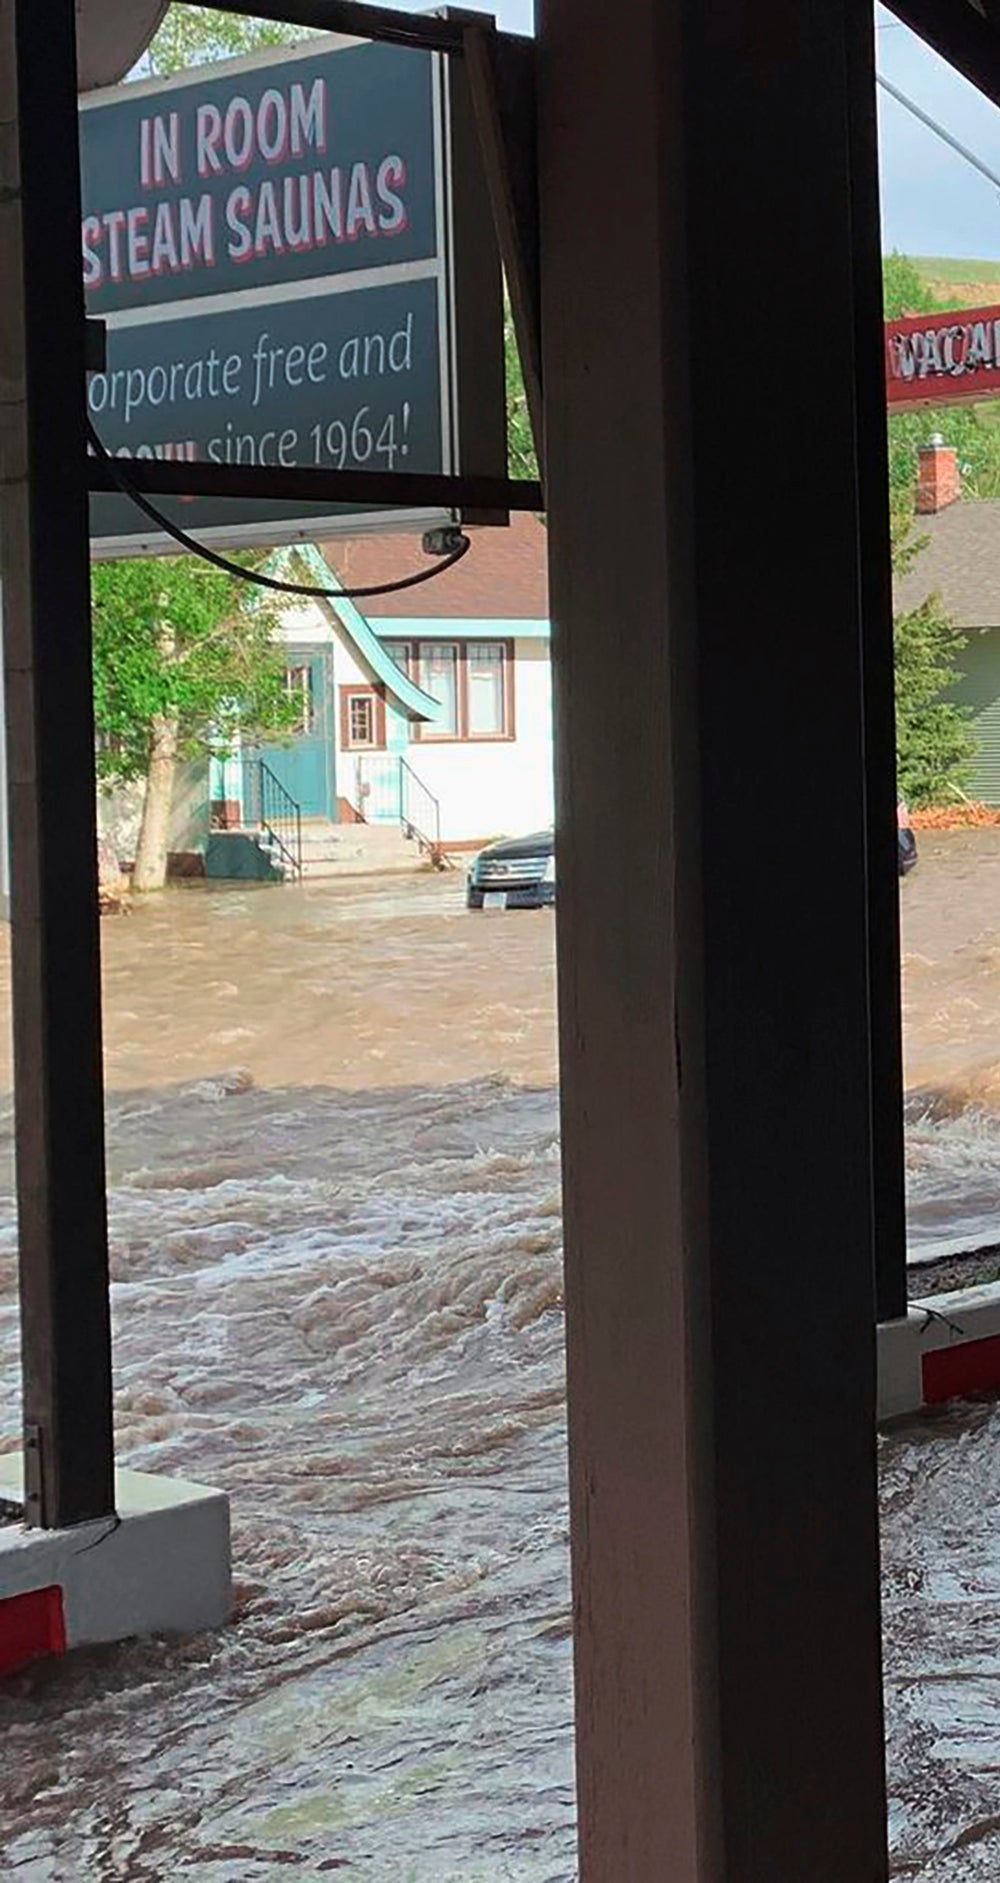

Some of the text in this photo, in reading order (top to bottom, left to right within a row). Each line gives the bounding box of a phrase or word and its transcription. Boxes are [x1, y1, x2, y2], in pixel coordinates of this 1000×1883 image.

[139, 78, 326, 187] IN ROOM
[82, 154, 408, 289] STEAM SAUNAS
[87, 312, 414, 423] orporate free and
[207, 401, 410, 470] since 1964!
